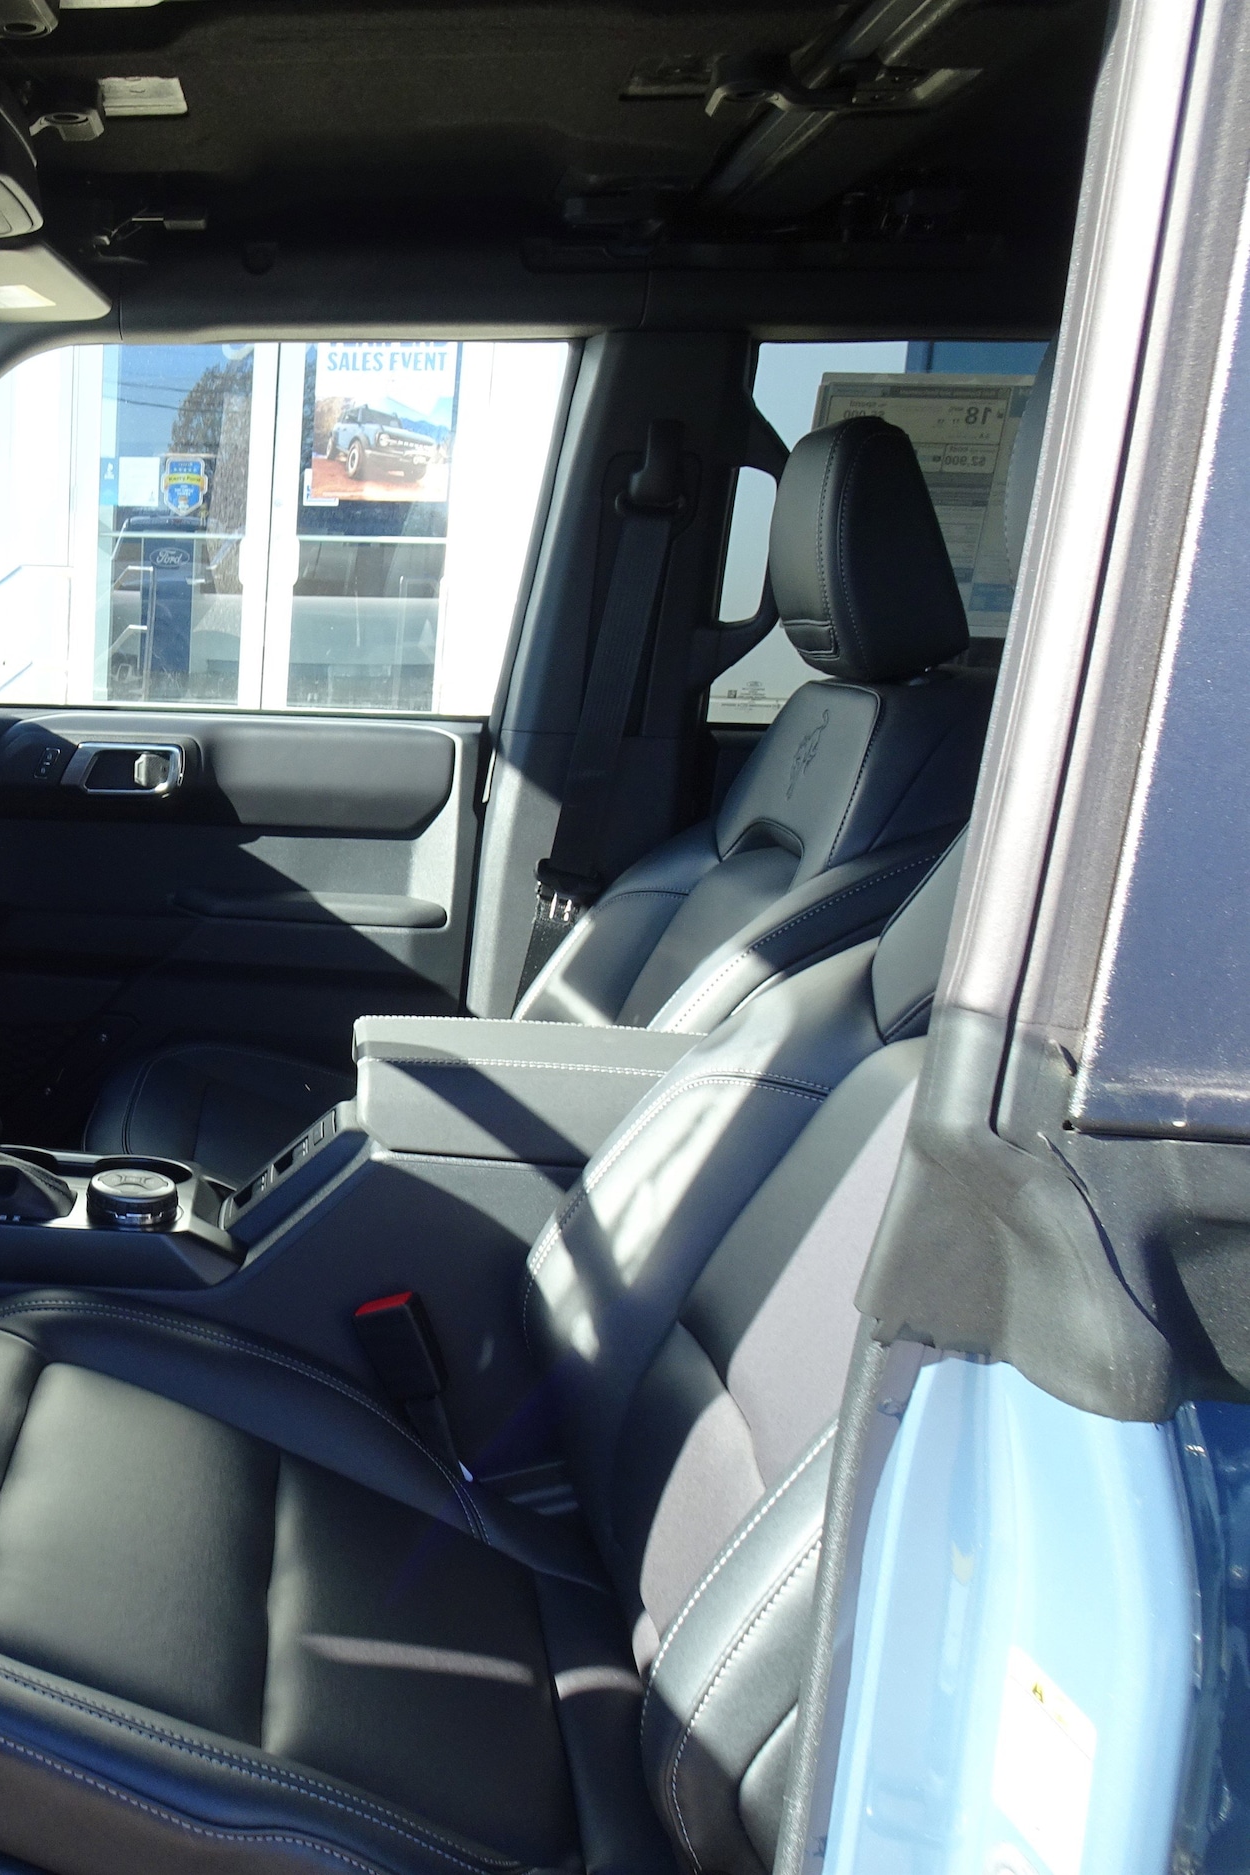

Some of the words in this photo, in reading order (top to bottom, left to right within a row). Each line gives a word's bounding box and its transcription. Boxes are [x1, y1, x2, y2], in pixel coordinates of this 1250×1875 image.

[327, 352, 384, 372] SALES
[389, 352, 448, 372] EVENT
[156, 549, 183, 565] Ford
